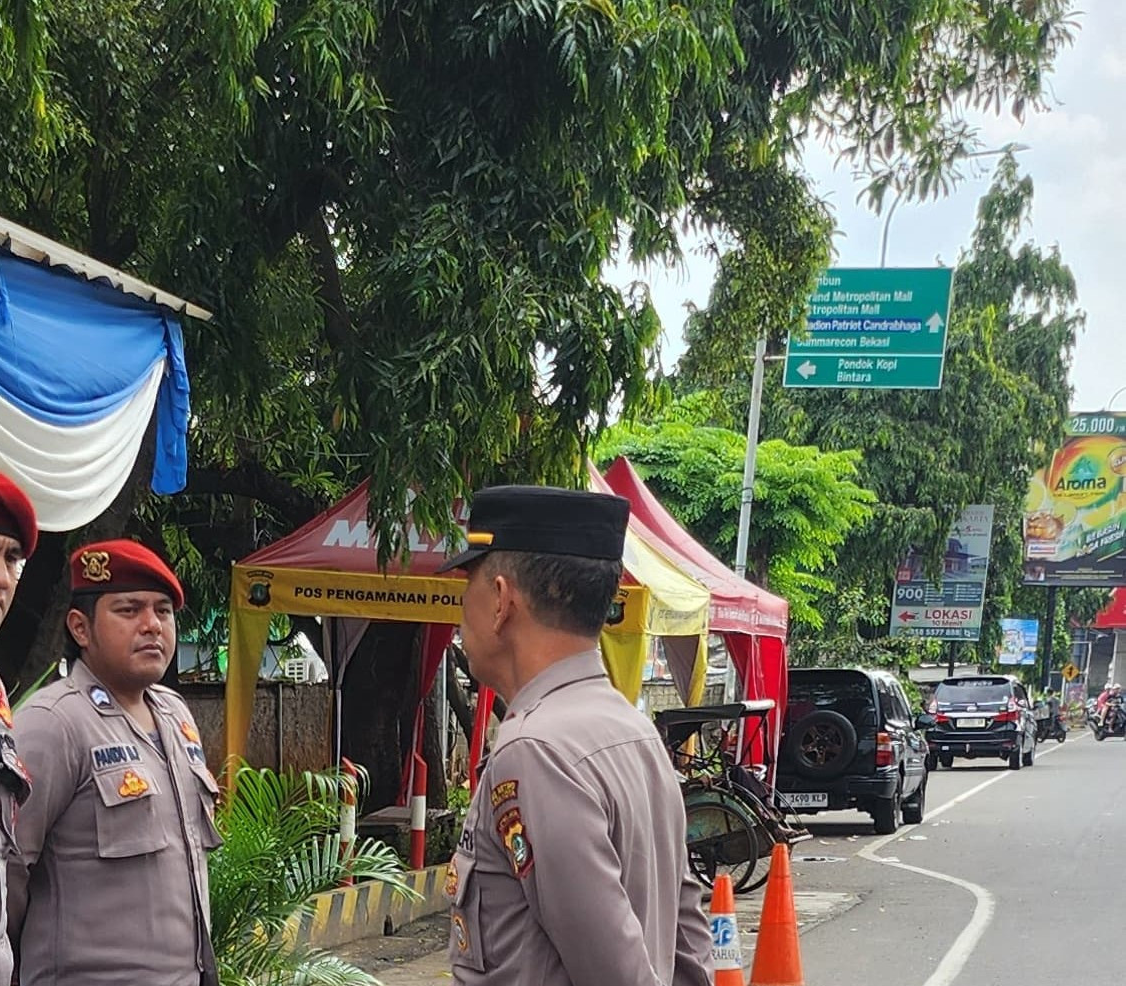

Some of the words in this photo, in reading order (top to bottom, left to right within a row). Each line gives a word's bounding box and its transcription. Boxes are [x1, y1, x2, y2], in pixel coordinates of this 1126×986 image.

[807, 291, 831, 302] rand
[832, 290, 891, 304] Metropolitan
[893, 290, 913, 302] Mall
[806, 303, 859, 316] tropolitan
[860, 303, 880, 315] Mall
[807, 320, 831, 331] adion
[832, 320, 862, 331] Patriot
[863, 319, 922, 333] Candrabhaga
[859, 336, 890, 348] Bekasi
[838, 358, 874, 370] Pondok
[876, 358, 898, 372] Kopi
[836, 371, 872, 383] Bintara
[1054, 476, 1107, 492] Aroma
[294, 586, 323, 599] POS
[327, 588, 428, 605] PENGAMANAN
[897, 588, 924, 600] 900
[924, 609, 973, 620] LOKASI
[460, 829, 474, 851] RI
